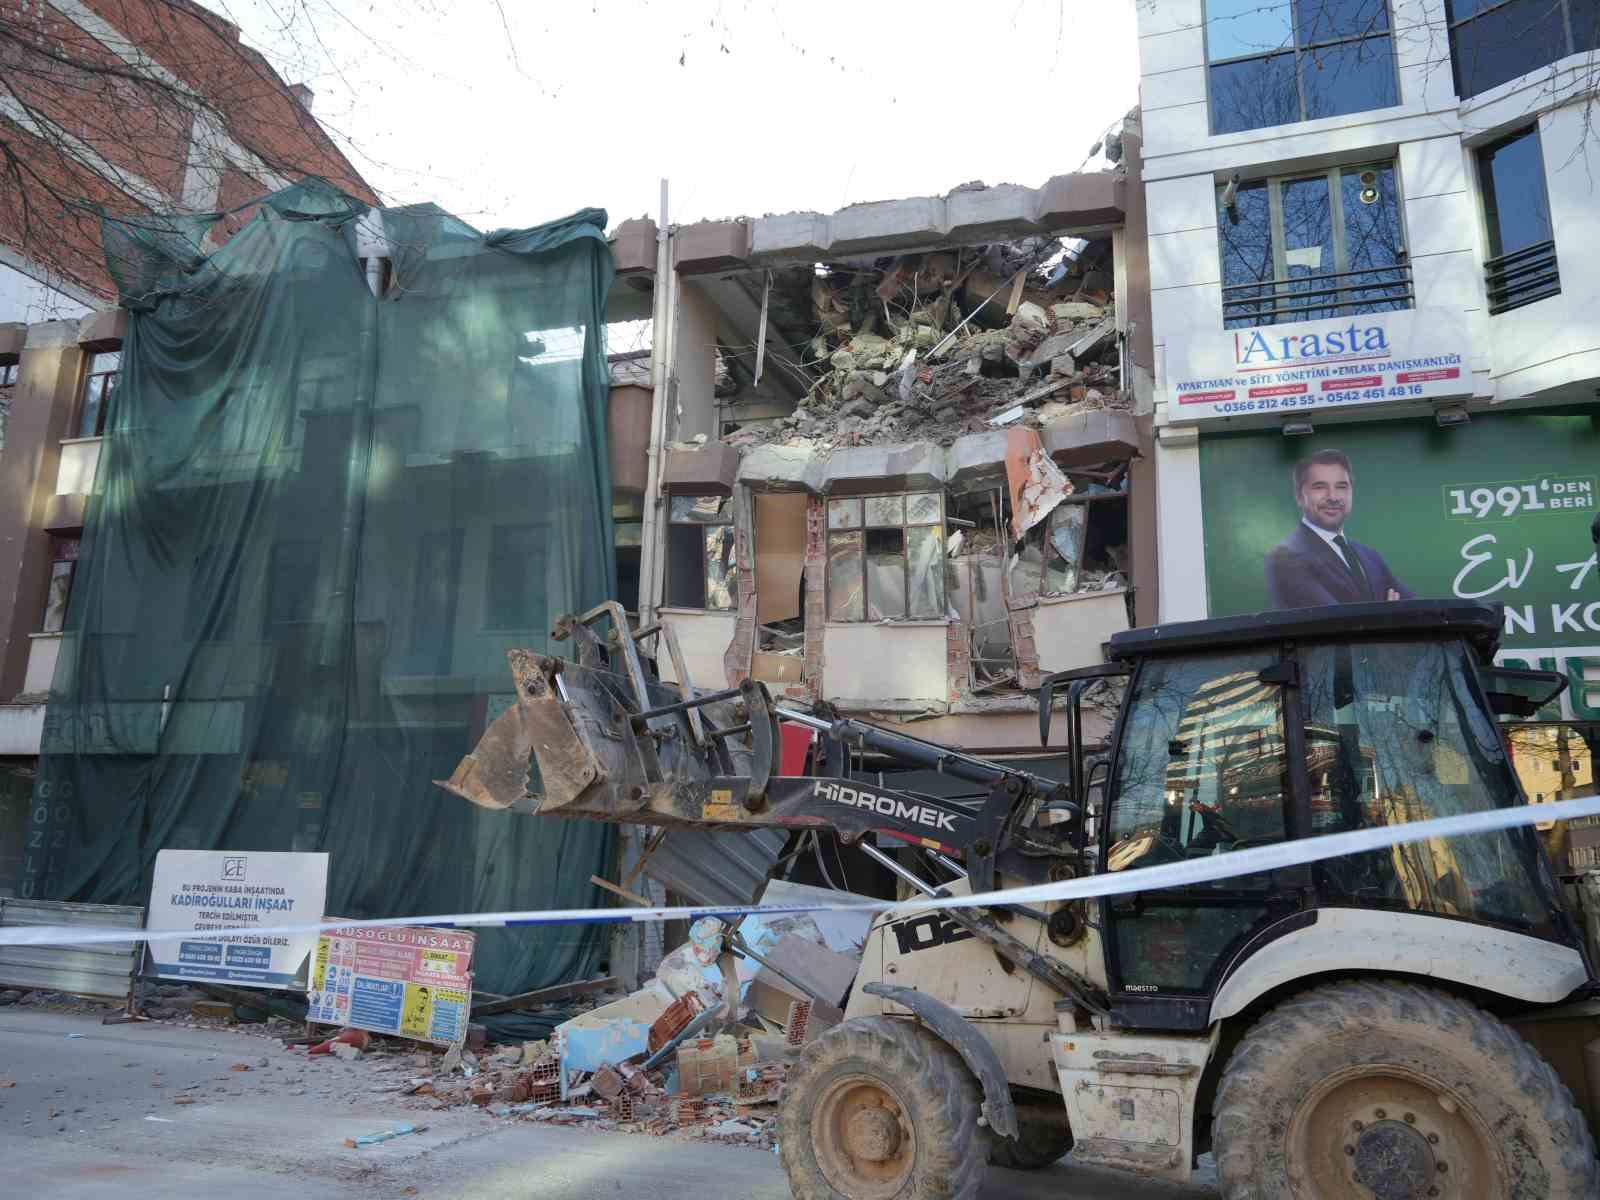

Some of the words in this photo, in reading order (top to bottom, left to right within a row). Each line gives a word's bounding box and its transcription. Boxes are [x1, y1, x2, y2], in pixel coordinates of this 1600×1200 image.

[1241, 323, 1389, 364] Arasta
[1176, 378, 1232, 391] APARTMAN
[1235, 378, 1247, 386] ve
[1250, 374, 1273, 385] SİTE
[1277, 366, 1329, 381] YÖNETİMİ
[1339, 363, 1376, 376] EMLAK
[1223, 400, 1255, 412] 0366
[1258, 399, 1278, 409] 212
[1281, 396, 1296, 406] 45
[1299, 394, 1315, 405] 55
[1327, 391, 1360, 402] 0542
[1408, 385, 1422, 395] 16
[1550, 493, 1593, 509] BERİ
[1452, 533, 1534, 599] Ev
[182, 884, 192, 892] BU
[224, 885, 242, 894] KABA
[171, 893, 252, 909] KADİROĞULLARI
[255, 894, 295, 913] İNŞAAT
